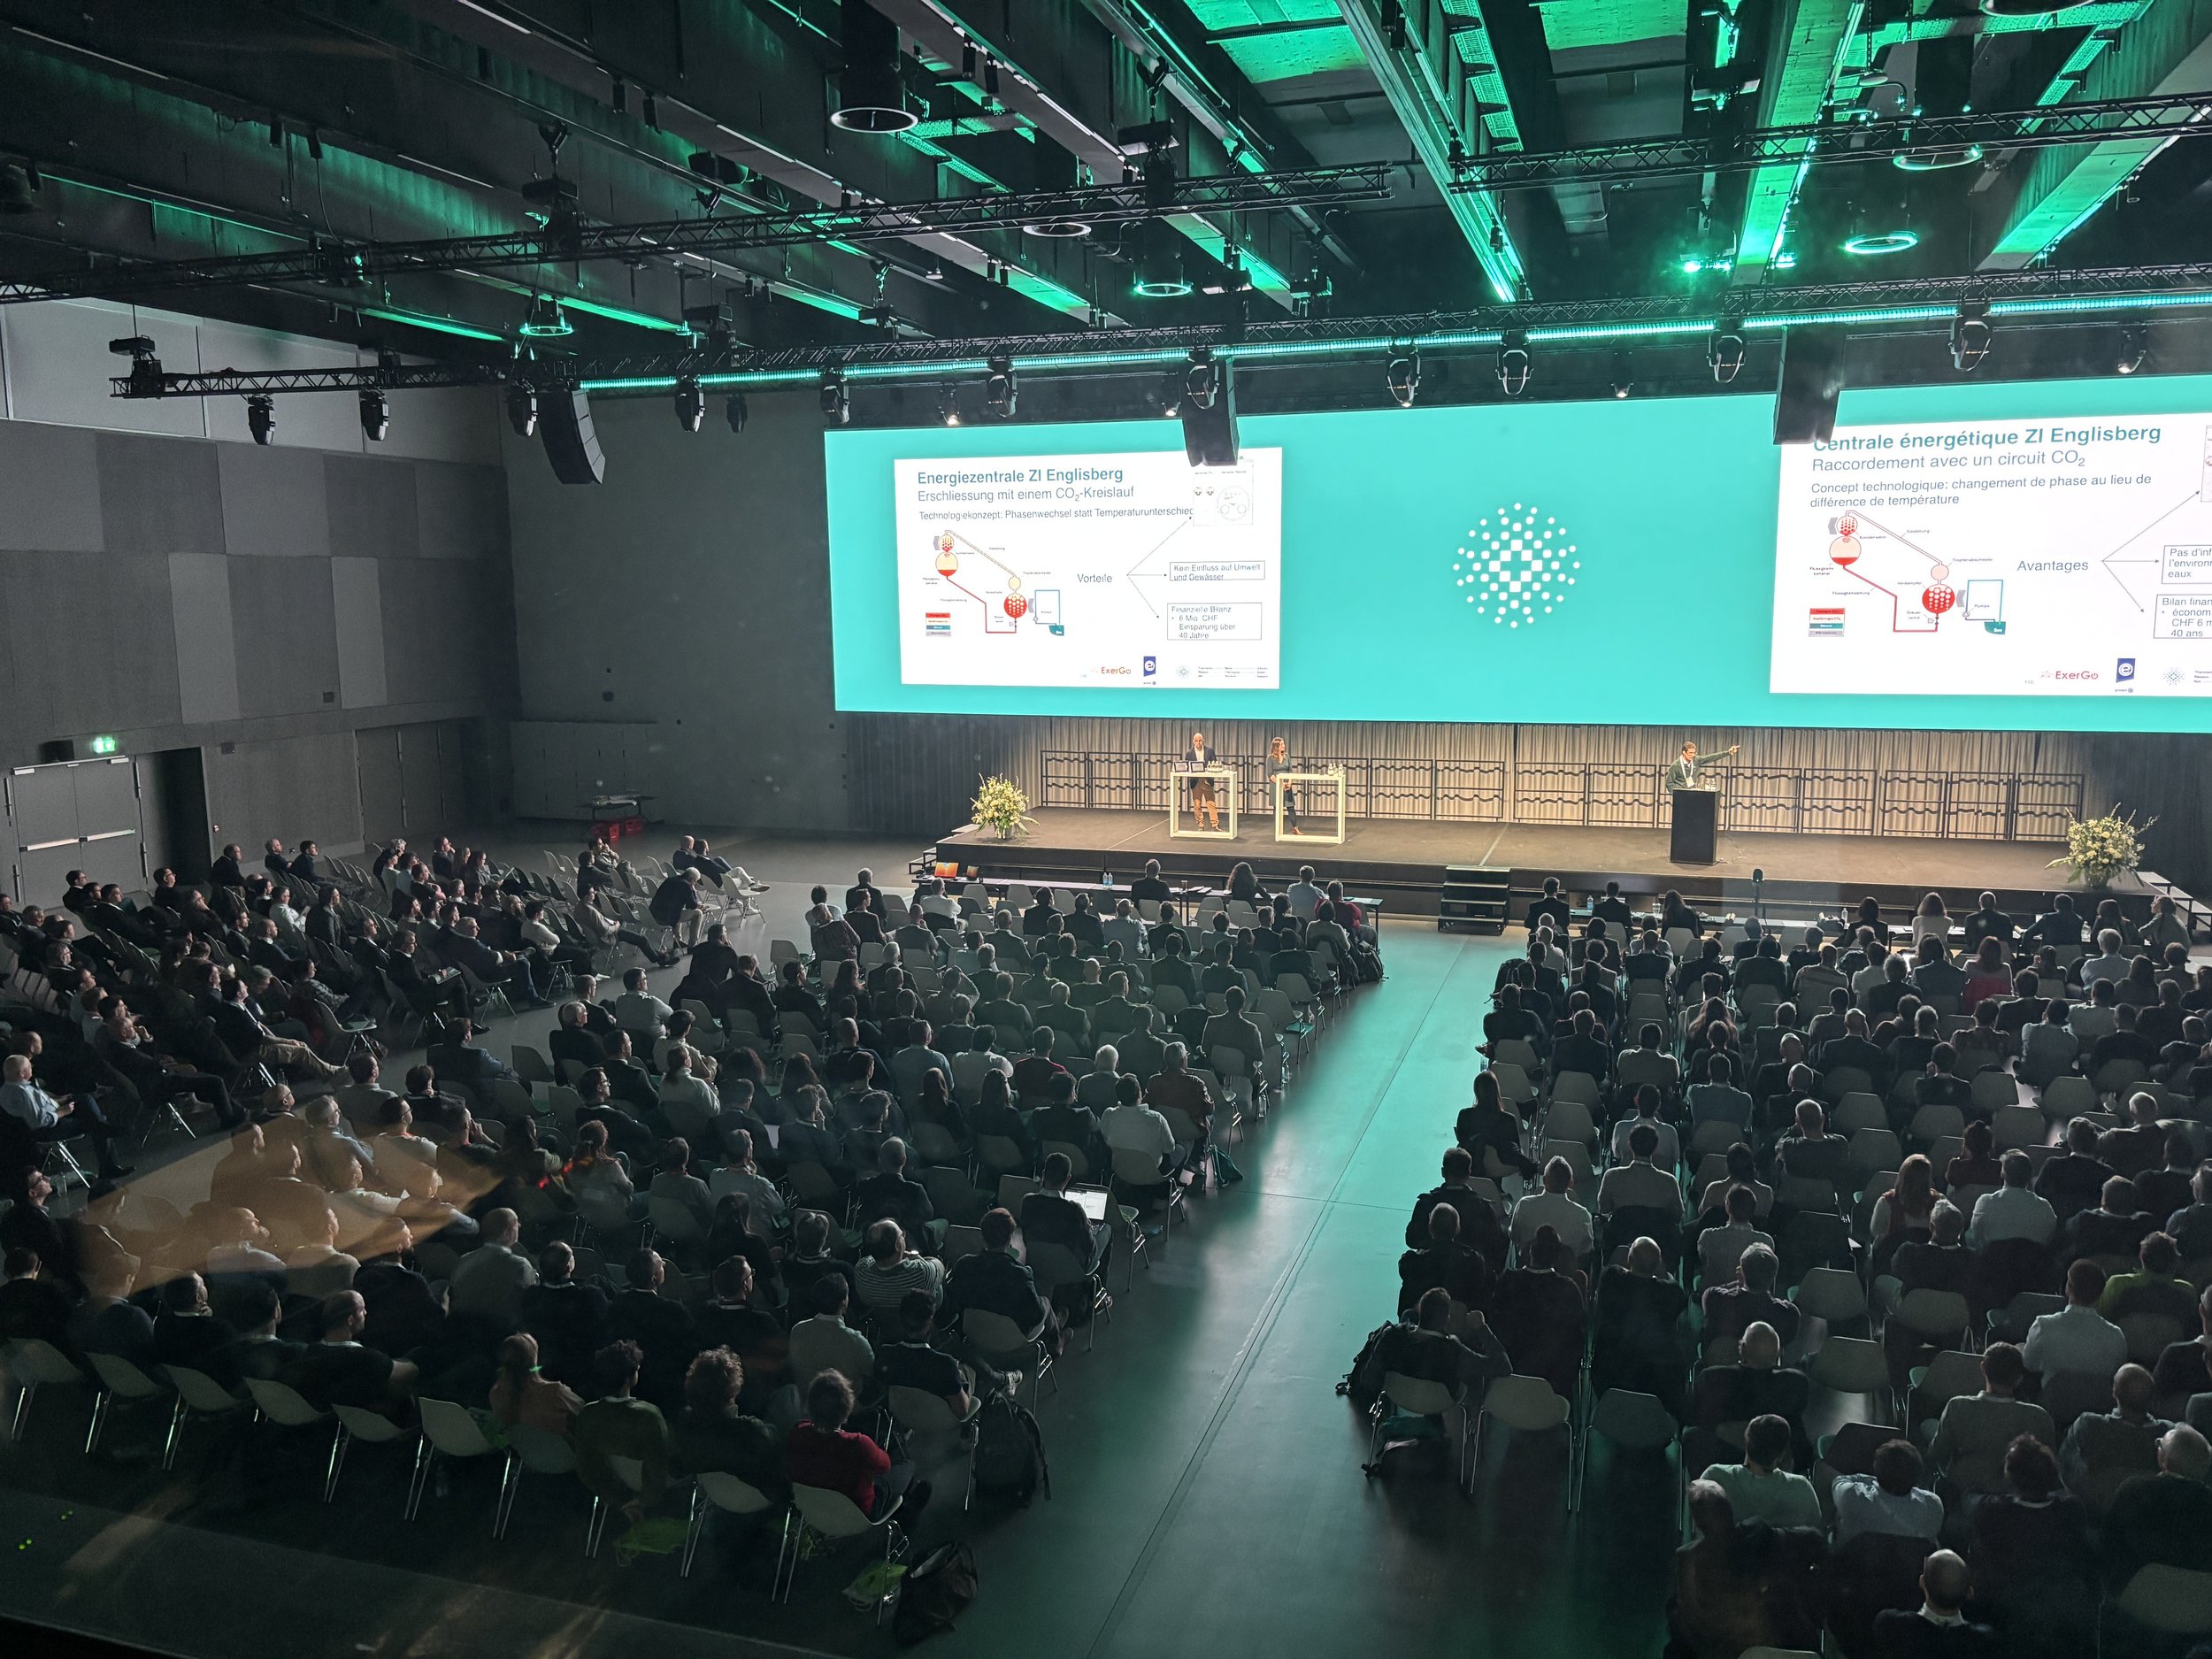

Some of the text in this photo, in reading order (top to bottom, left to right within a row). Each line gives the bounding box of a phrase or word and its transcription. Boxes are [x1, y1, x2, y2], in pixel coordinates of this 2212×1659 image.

[1814, 426, 2162, 451] Centrale énergétique ZI Englisberg
[1812, 456, 1924, 472] Raccordement
[1930, 457, 1968, 468] avec
[1973, 456, 1992, 466] un
[1998, 451, 2046, 465] circuit
[918, 468, 1124, 487] Energiezentrale ZI Englisberg
[1811, 474, 2151, 494] Concept technologique: changement de phase au lieu de
[918, 490, 994, 503] Erschliessung
[997, 489, 1014, 500] mit
[1018, 490, 1052, 500] einem
[1810, 495, 1960, 508] différence de température
[1005, 509, 1071, 518] Phasenwechsel
[1074, 509, 1092, 518] statt
[2017, 560, 2089, 573] Avantages
[1077, 573, 1113, 583] Vorteile
[2055, 671, 2099, 680] ExerGo
